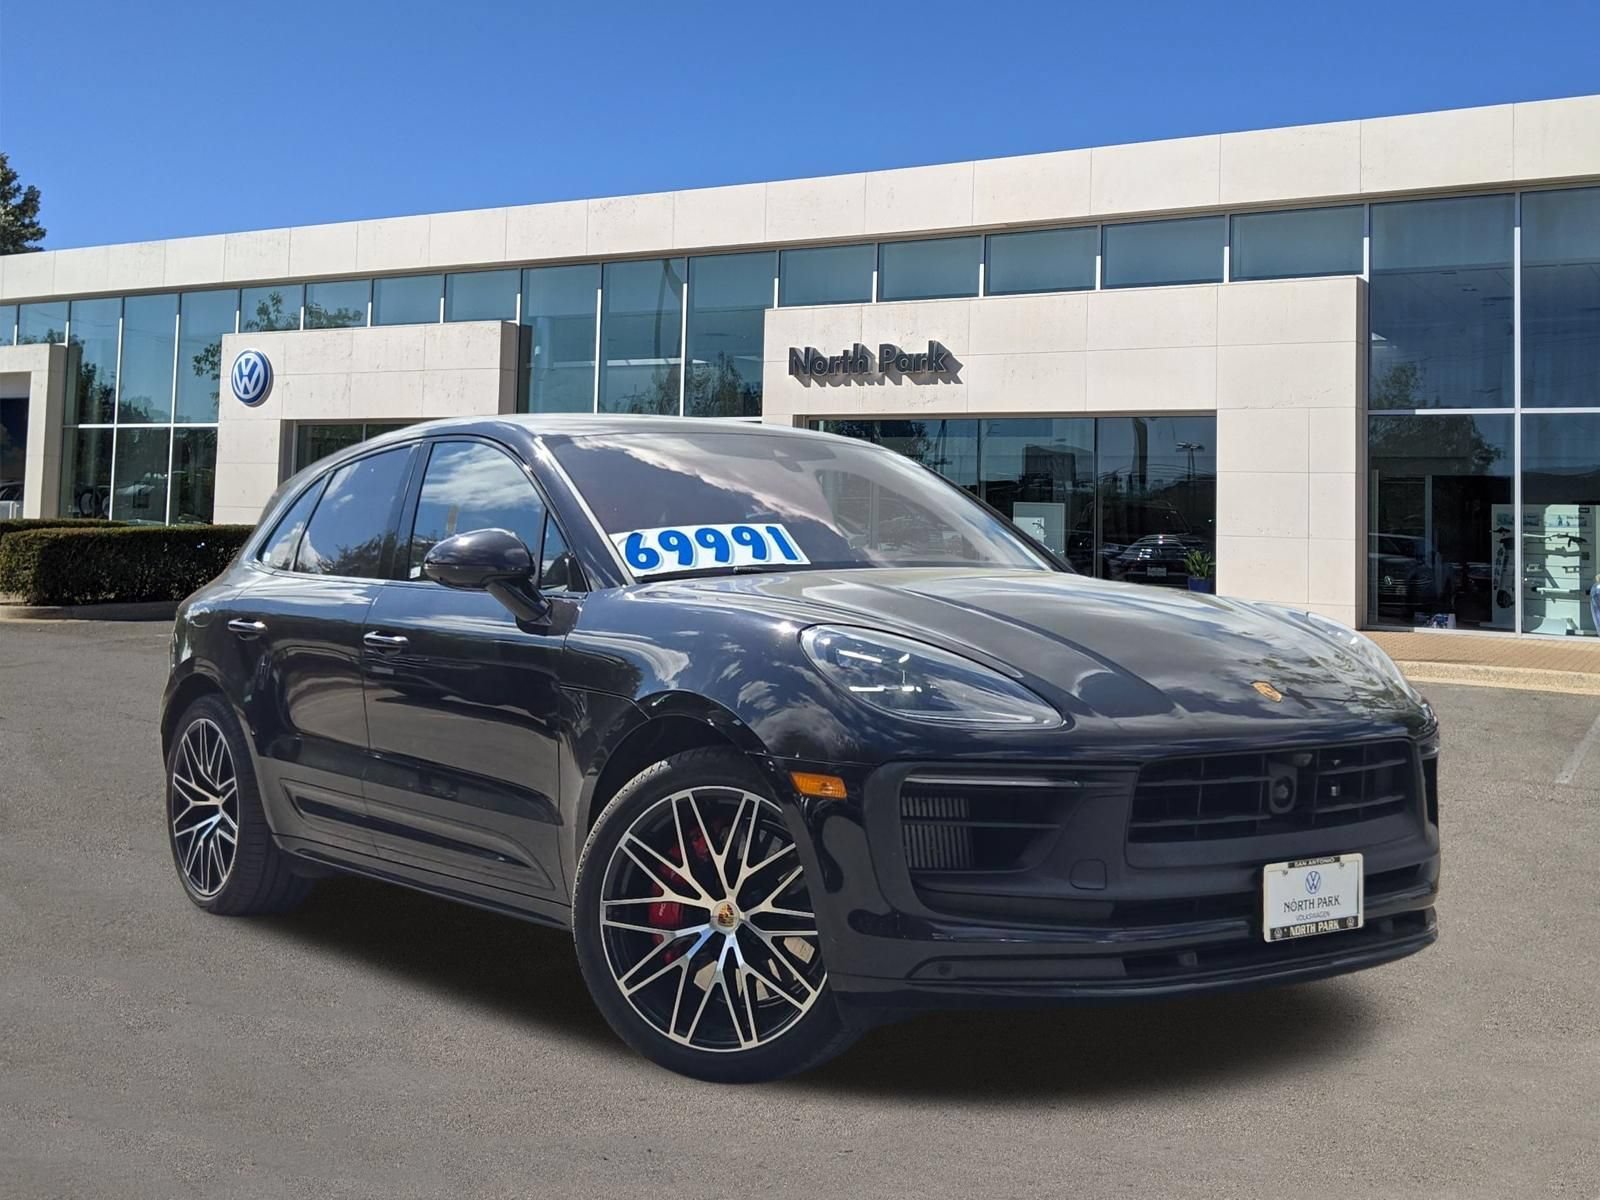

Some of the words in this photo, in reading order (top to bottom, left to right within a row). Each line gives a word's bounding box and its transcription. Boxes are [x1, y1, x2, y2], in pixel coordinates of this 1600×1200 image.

[788, 343, 872, 376] North
[878, 340, 949, 373] Park
[625, 525, 799, 570] 69991
[1283, 898, 1315, 912] NORTH
[1317, 895, 1341, 909] PARK
[1296, 911, 1331, 921] VOLKSWAGEN
[1289, 923, 1316, 936] NORTH
[1318, 919, 1340, 932] PARK
